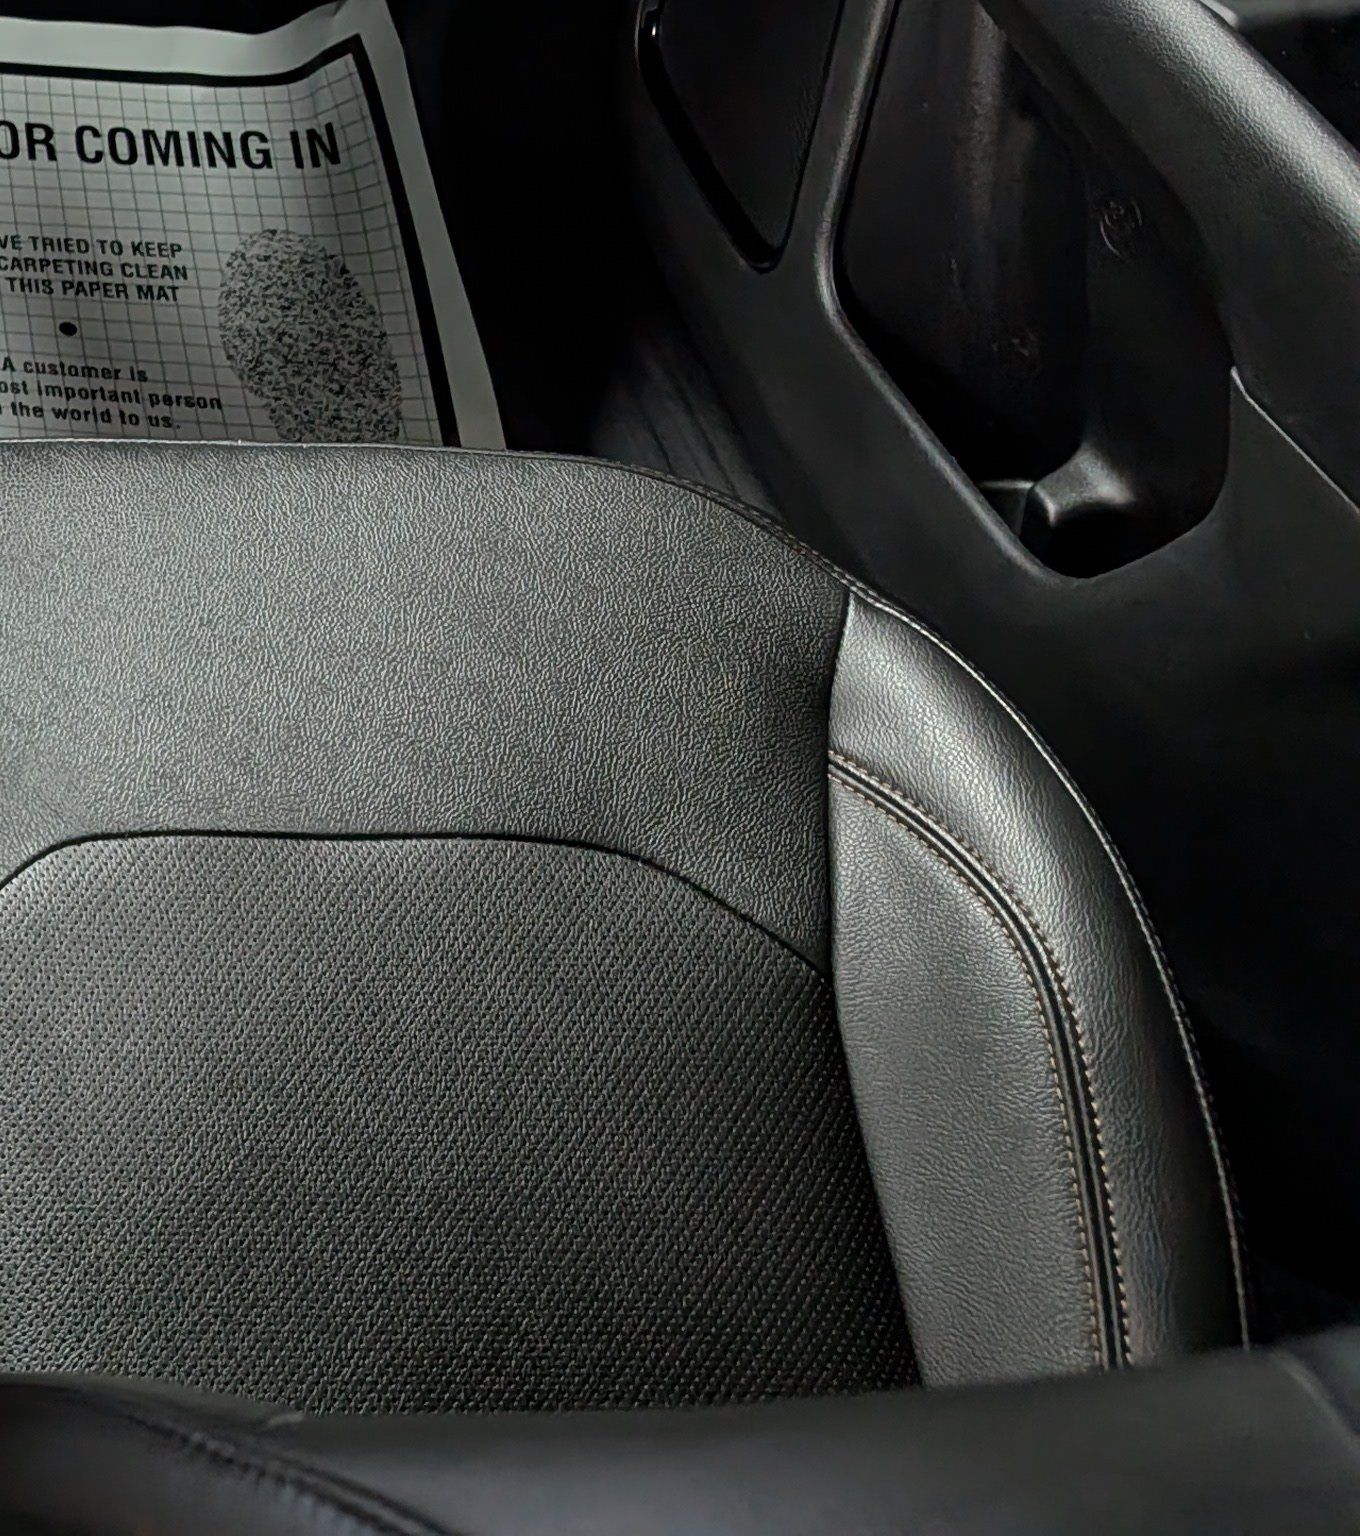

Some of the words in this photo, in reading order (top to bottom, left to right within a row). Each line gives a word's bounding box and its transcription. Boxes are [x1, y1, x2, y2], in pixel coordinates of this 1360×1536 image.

[75, 125, 274, 170] COMING
[289, 121, 341, 170] IN
[28, 236, 91, 254] TRIED
[96, 239, 124, 256] TO
[131, 240, 183, 258] KEEP
[120, 263, 188, 281] CLEAN
[4, 276, 54, 295] THIS
[61, 280, 129, 300] PAPER
[136, 285, 181, 303] MAT
[1, 356, 16, 372] A
[23, 360, 122, 381] customer
[130, 366, 148, 382] is
[37, 379, 141, 405] important
[148, 390, 223, 410] person
[10, 401, 44, 419] the
[51, 405, 112, 424] world
[119, 409, 140, 426] to
[148, 413, 181, 430] us.
